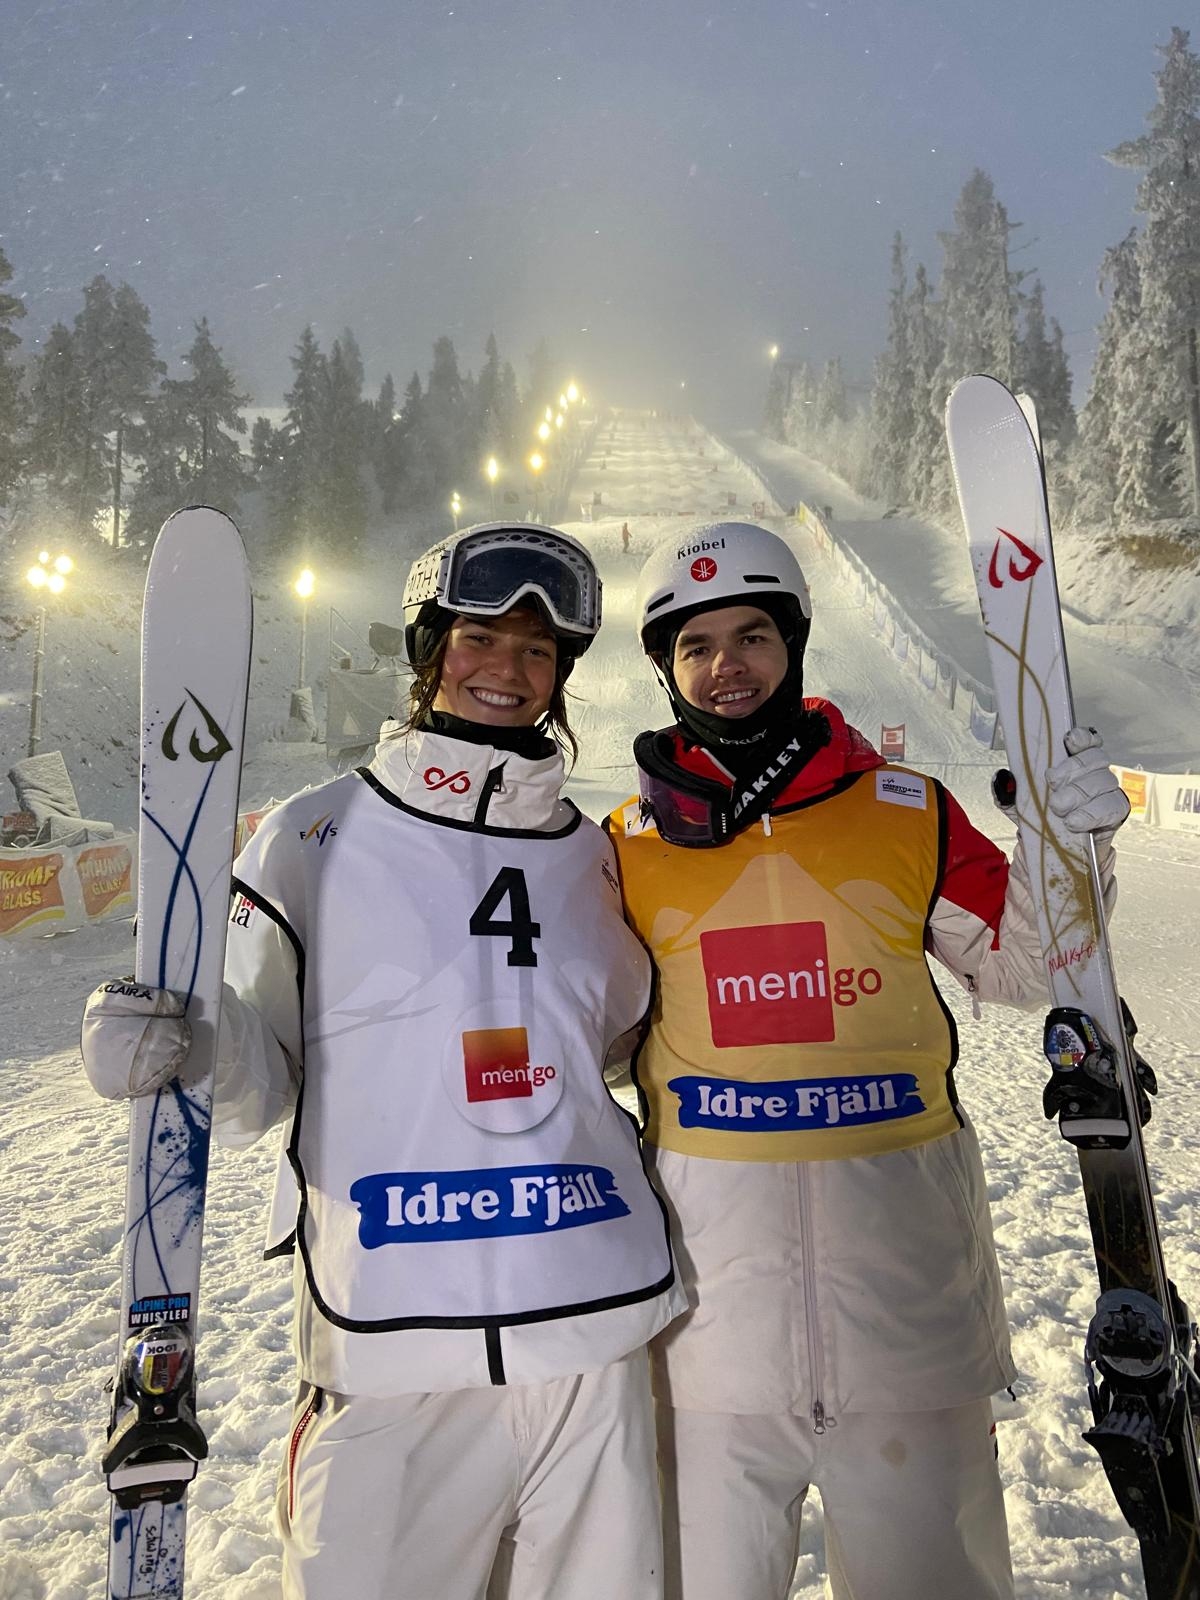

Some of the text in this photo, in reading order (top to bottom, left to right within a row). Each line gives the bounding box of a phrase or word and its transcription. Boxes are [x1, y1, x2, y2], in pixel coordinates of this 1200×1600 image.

[734, 737, 801, 819] OAKLEY
[2, 889, 42, 910] GLASS
[469, 866, 541, 968] 4
[716, 959, 882, 1007] menigo
[481, 1062, 556, 1087] menigo
[698, 1080, 898, 1124] Idre Fjäll
[385, 1172, 606, 1227] Idre Fjäll
[131, 1309, 188, 1324] WHISTLER
[132, 1297, 188, 1312] ALPINE PRO
[147, 1343, 178, 1354] LOOK
